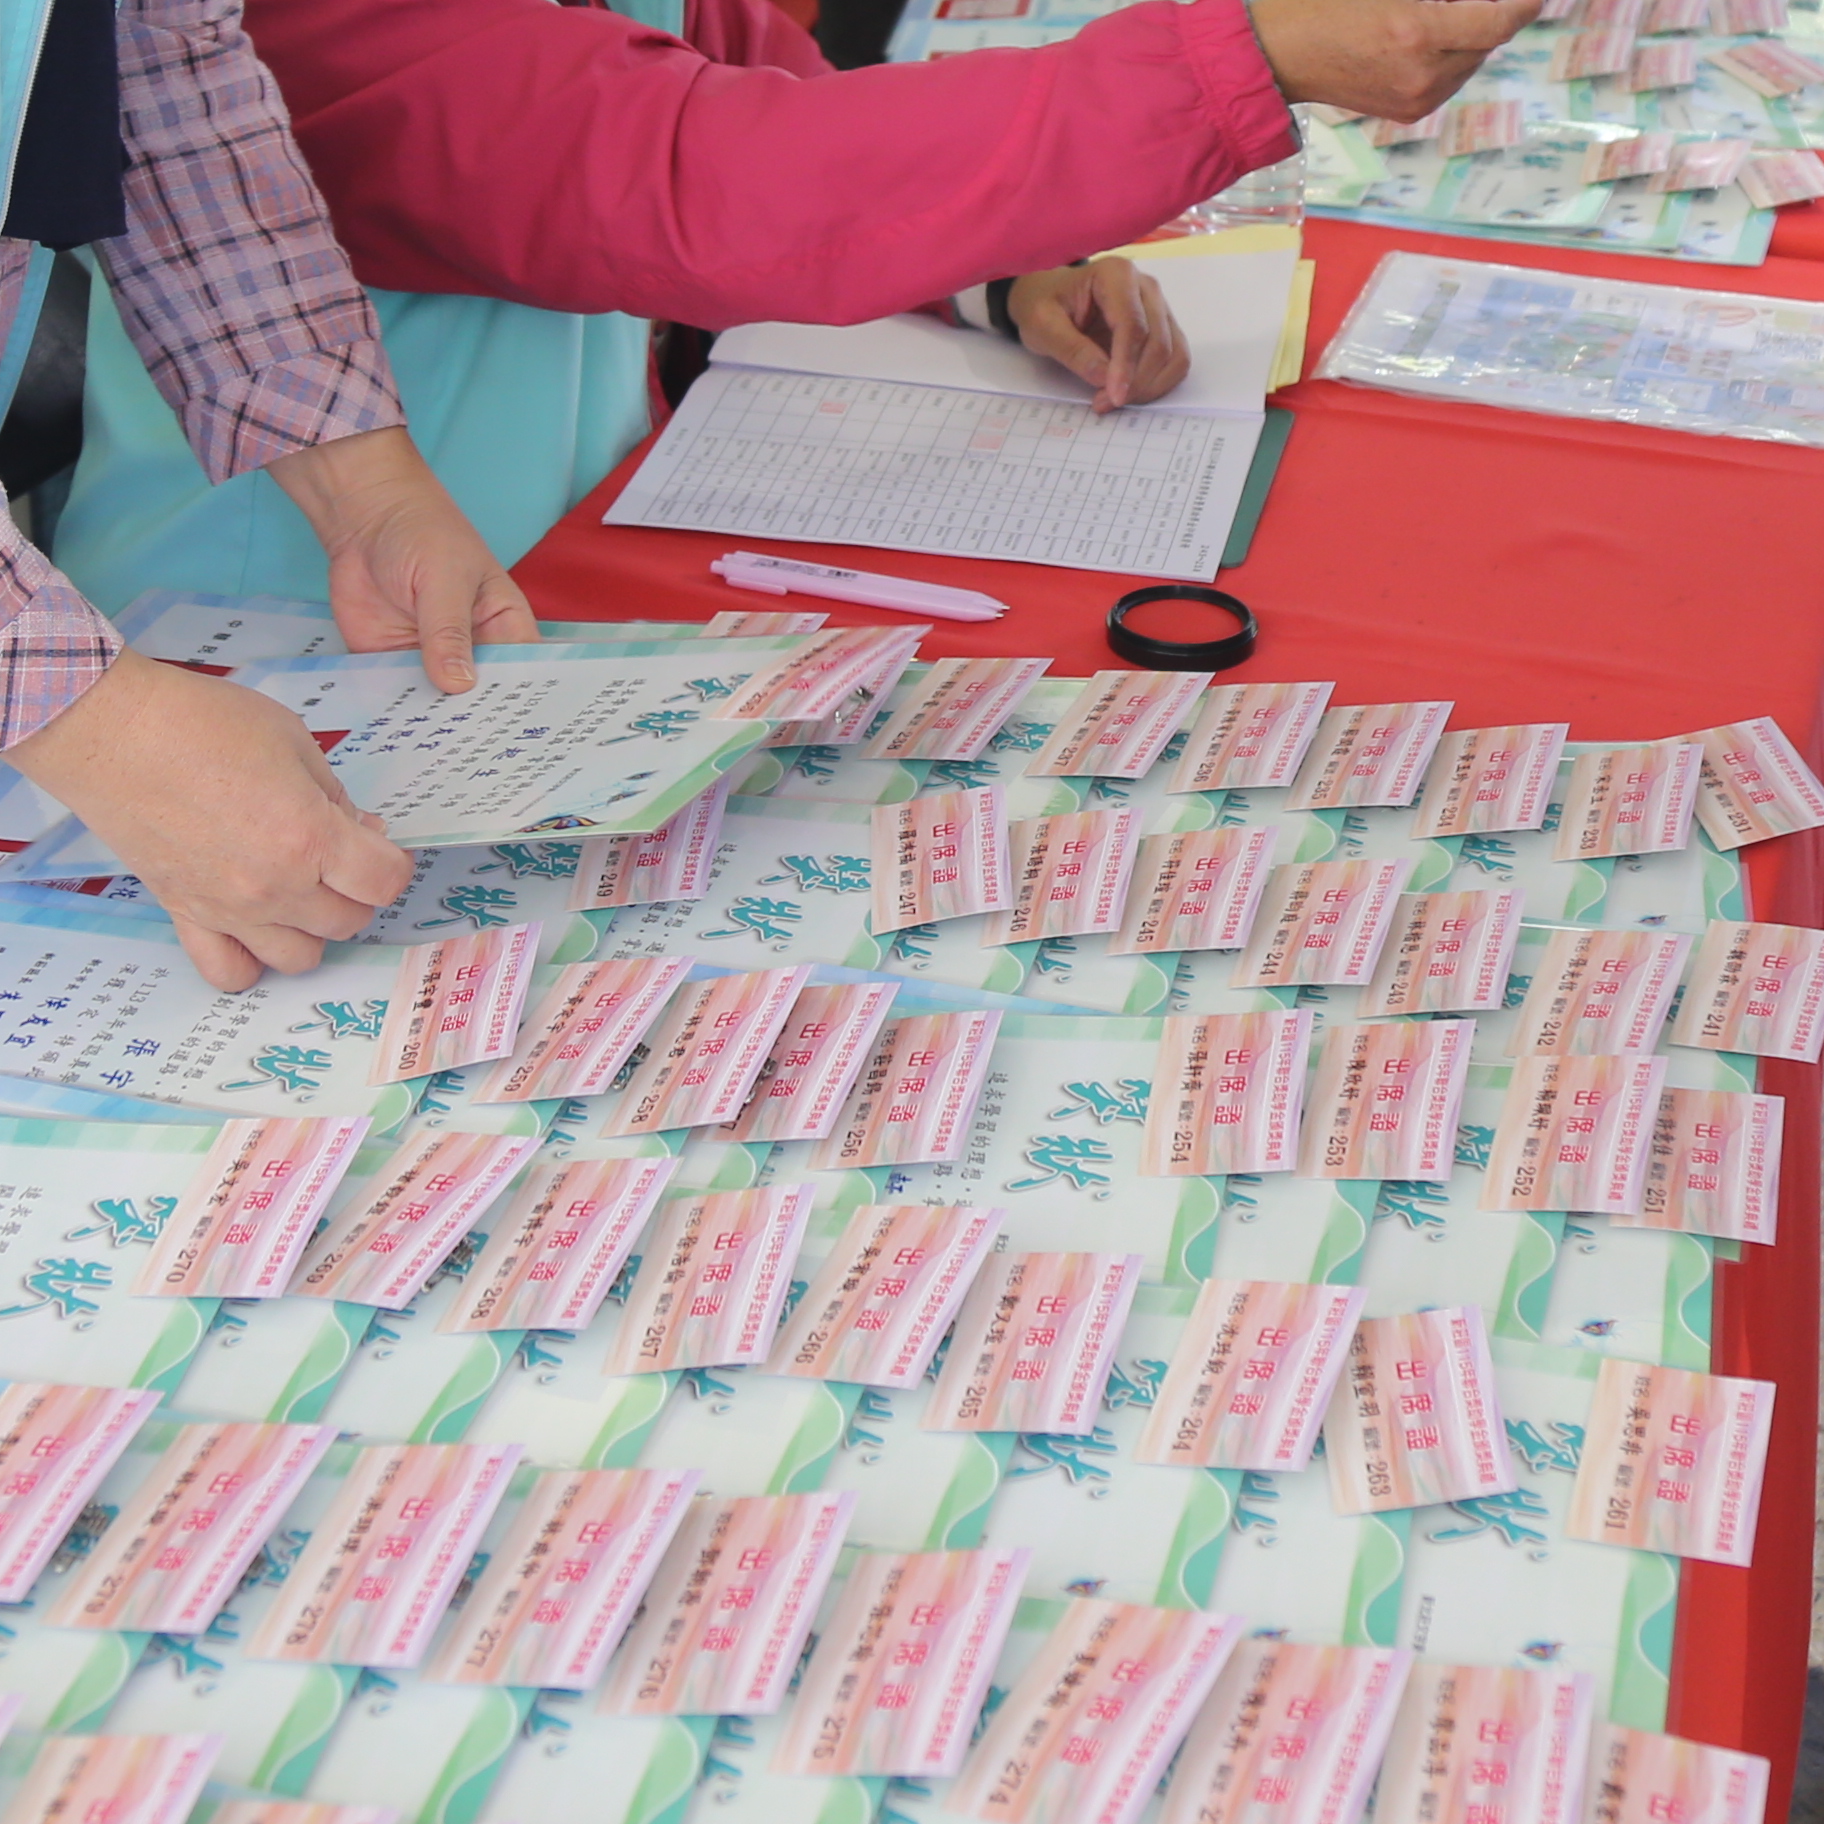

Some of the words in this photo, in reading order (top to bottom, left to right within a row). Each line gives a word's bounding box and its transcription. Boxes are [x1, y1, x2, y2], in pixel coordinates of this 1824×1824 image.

[934, 682, 987, 728] 出席證
[1099, 695, 1149, 744] 出席證
[1235, 708, 1274, 757] 出席證
[1353, 727, 1393, 775] 出席證
[1476, 750, 1510, 800] 出席證
[1723, 751, 1774, 803] 出席證
[1618, 772, 1647, 822] 出席證
[932, 822, 956, 882] 出席證
[1050, 840, 1085, 899] 出席證
[1180, 857, 1217, 914] 出席證
[1305, 889, 1346, 947] 出席證
[1429, 919, 1465, 975] 出席證
[441, 964, 478, 1031] 出席證
[1584, 959, 1626, 1017] 出席證
[1747, 955, 1786, 1016] 出席證
[4, 997, 70, 1048] 侯友宜
[558, 992, 620, 1058] 出席證
[683, 1010, 739, 1084] 出席證
[771, 1022, 825, 1096] 出席證
[888, 1051, 933, 1121] 出席證
[1214, 1049, 1249, 1123] 出席證
[1370, 1059, 1408, 1130] 出席證
[1559, 1090, 1599, 1162] 出席證
[1688, 1123, 1720, 1189] 出席證
[224, 1160, 290, 1243] 出席證
[370, 1174, 455, 1252] 出席證
[529, 1200, 595, 1279] 出席證
[691, 1231, 741, 1314] 出席證
[856, 1248, 923, 1329] 出席證
[1013, 1296, 1065, 1379] 出席證
[1231, 1328, 1286, 1413] 出席證
[1396, 1360, 1436, 1448] 出席證
[1658, 1414, 1699, 1501] 出席證
